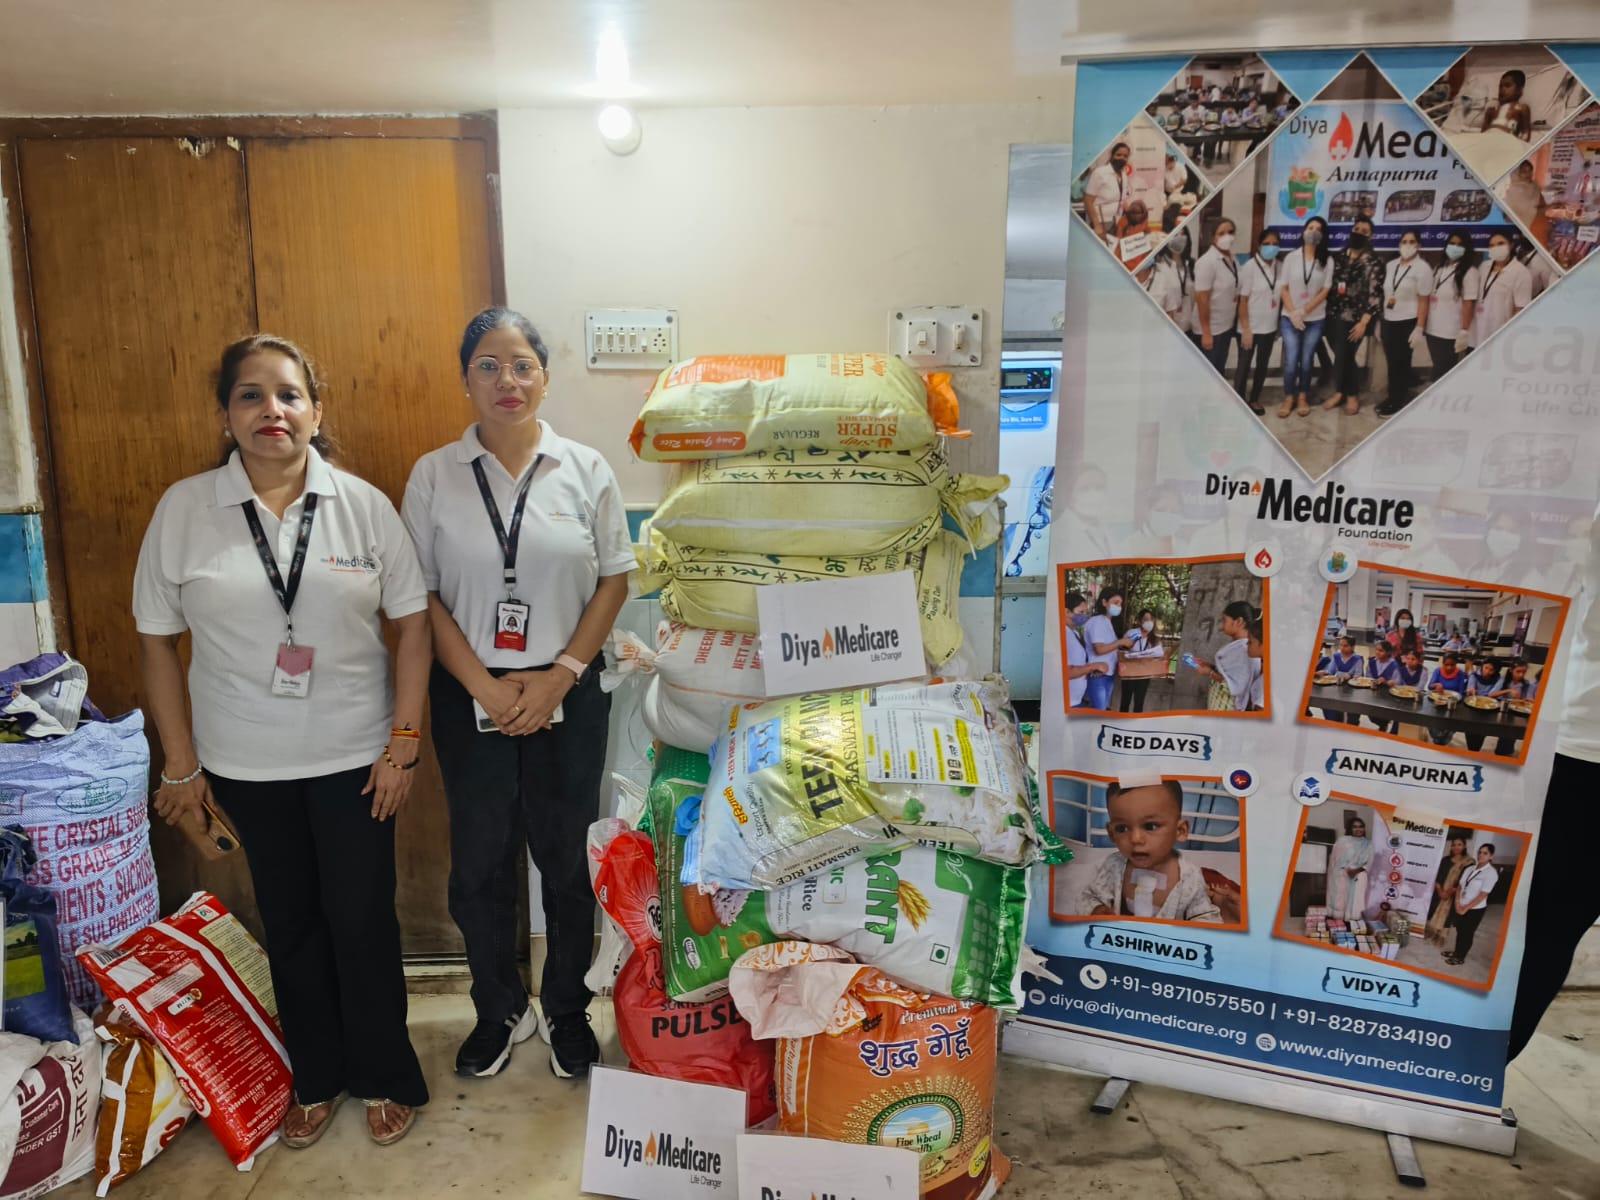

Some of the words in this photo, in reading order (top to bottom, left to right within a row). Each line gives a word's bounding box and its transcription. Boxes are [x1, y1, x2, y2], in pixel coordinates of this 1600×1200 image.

[1289, 116, 1328, 138] Diya
[1326, 166, 1439, 187] Annapurna
[772, 428, 820, 441] REGULAR
[837, 422, 897, 437] SUPER
[1205, 473, 1250, 500] Diya
[1257, 478, 1414, 528] Medicare
[1338, 527, 1413, 542] Foundation
[780, 632, 820, 666] Diya
[835, 623, 900, 656] Medicare
[1111, 733, 1147, 750] RED
[1149, 736, 1201, 755] DAYS
[1338, 755, 1470, 786] ANNAPURNA
[54, 812, 124, 850] CRYSTAL
[809, 845, 861, 873] BASMATI
[775, 868, 806, 886] RICE
[1101, 933, 1199, 963] ASHIRWAD
[1342, 976, 1401, 998] VIDYA
[901, 1002, 958, 1025] Premium
[1110, 975, 1265, 1016] +91-9871057550
[1283, 1009, 1452, 1049] +91-8287834190
[859, 1040, 920, 1078] शुद्ध
[925, 1018, 973, 1059] गेहूँ
[1050, 994, 1247, 1045] diya@diyamedicare.org
[1279, 1039, 1494, 1093] www.diyamedicare.org
[46, 1123, 63, 1142] GST
[916, 1131, 942, 1143] Wheat
[605, 1124, 642, 1168] Diya
[657, 1133, 721, 1174] Medicare
